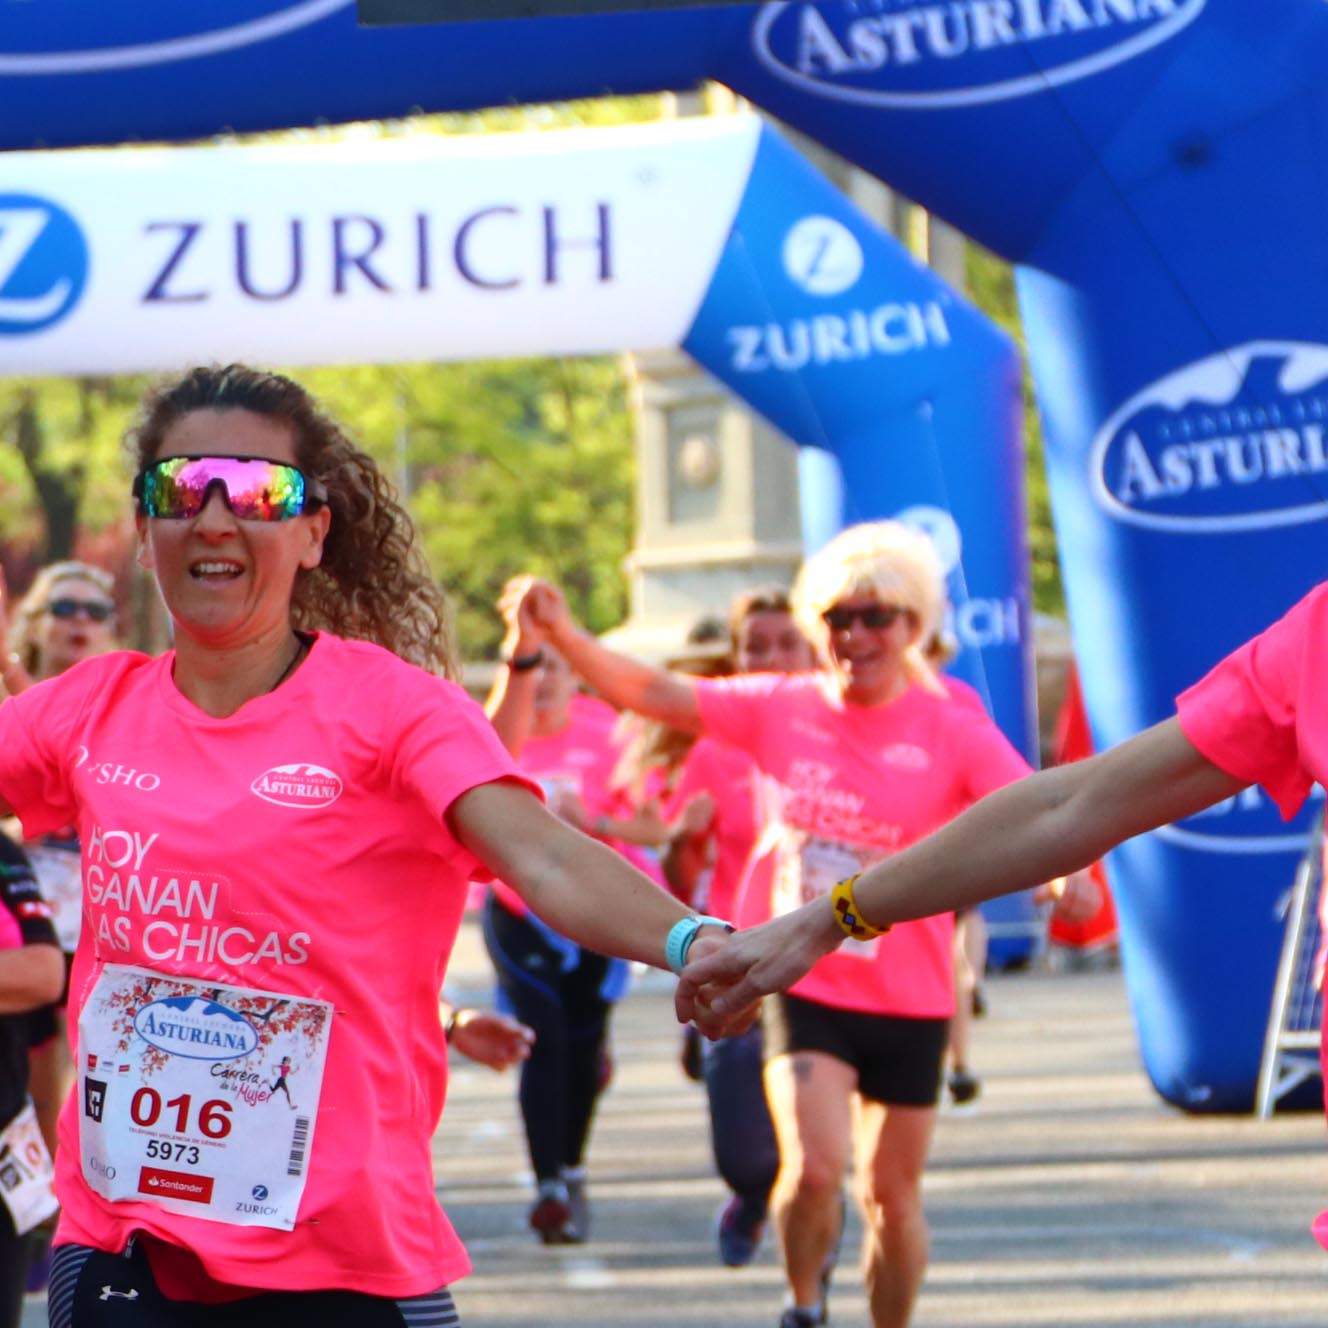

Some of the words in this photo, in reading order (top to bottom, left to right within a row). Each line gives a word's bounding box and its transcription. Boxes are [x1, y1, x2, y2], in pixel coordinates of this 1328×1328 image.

[141, 201, 614, 305] ZURICH
[725, 302, 951, 372] ZURICH
[87, 865, 218, 919] GANAN
[143, 921, 311, 966] CHICAS
[141, 1011, 247, 1051] ASTURIANA
[210, 1062, 259, 1084] Carrera
[130, 1087, 234, 1139] 016
[237, 1082, 272, 1107] Mujer
[146, 1140, 200, 1165] 5973
[159, 1178, 204, 1194] Santander
[235, 1202, 278, 1216] ZURICH
